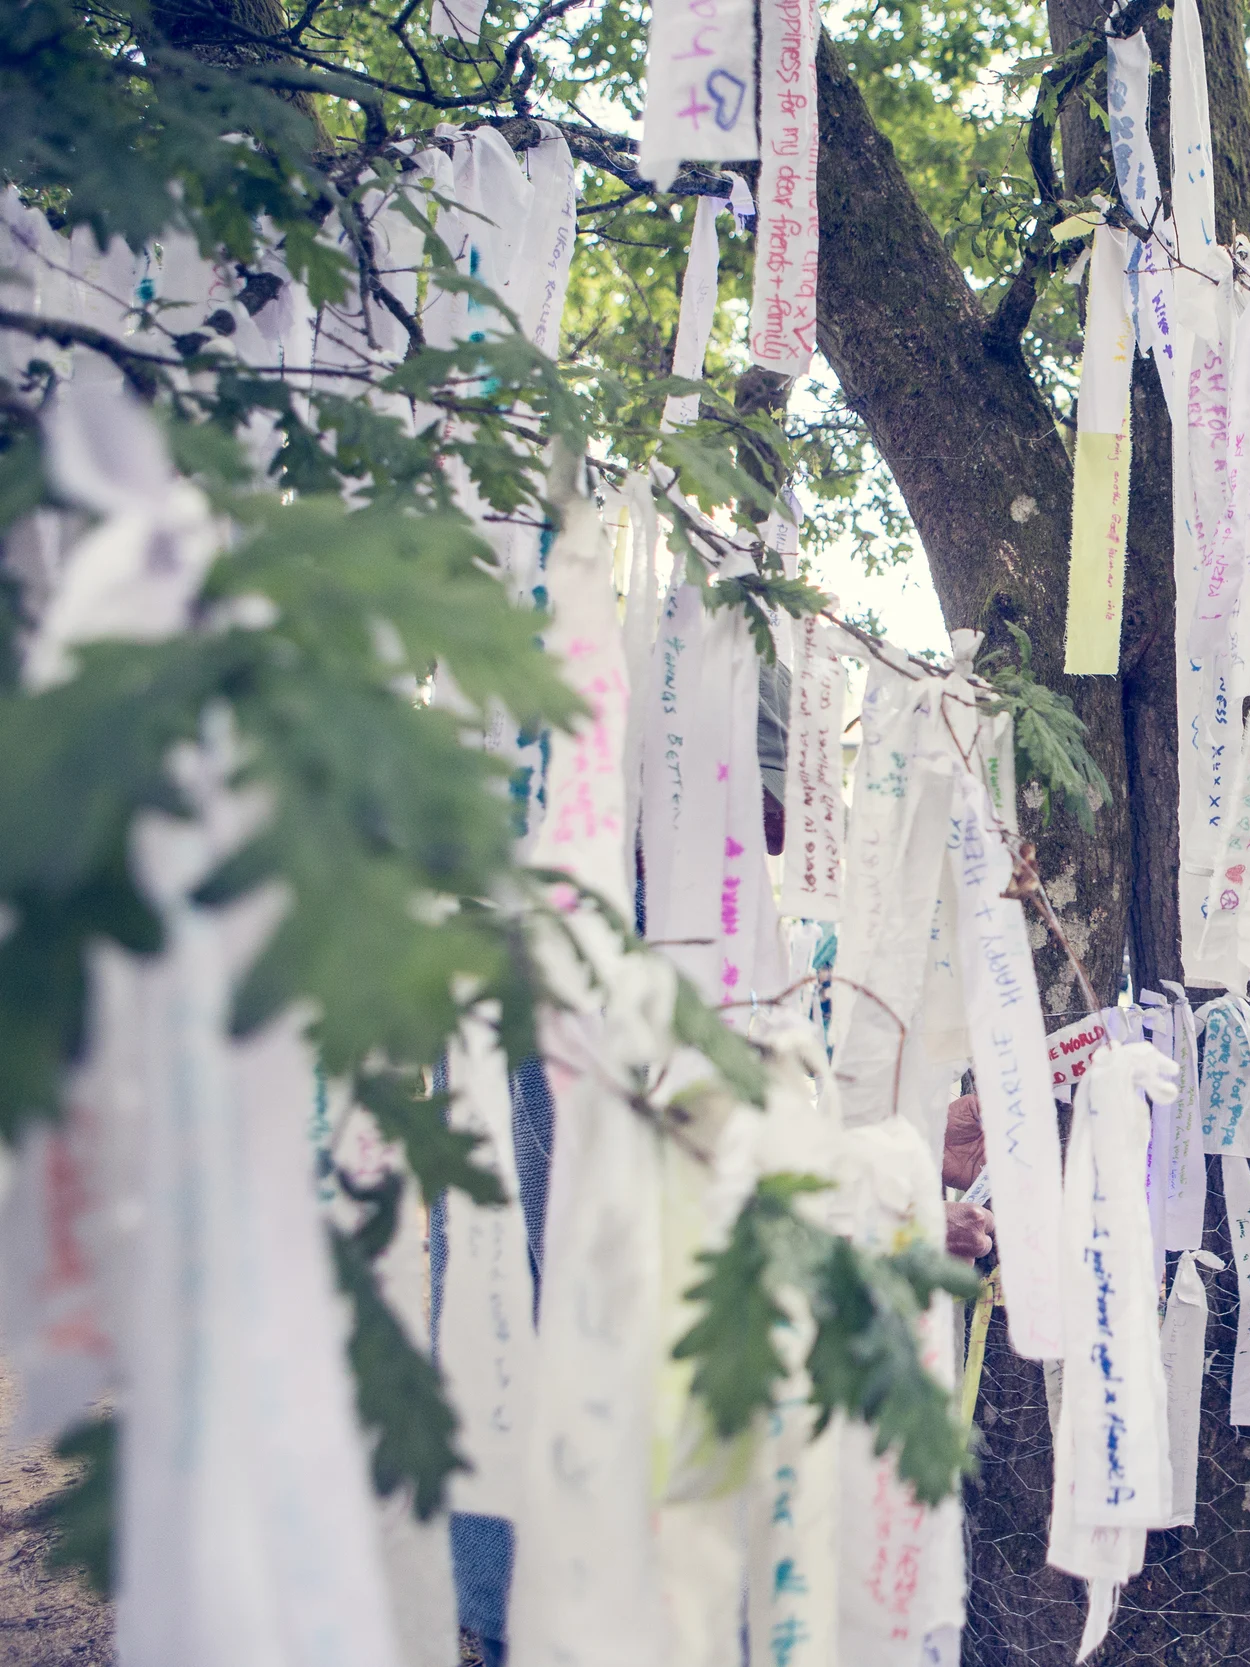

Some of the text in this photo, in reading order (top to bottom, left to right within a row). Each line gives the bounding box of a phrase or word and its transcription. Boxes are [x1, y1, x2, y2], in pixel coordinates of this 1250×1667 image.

[776, 88, 808, 121] for
[771, 126, 800, 157] my
[775, 166, 802, 209] dear
[752, 295, 792, 361] family
[979, 934, 1024, 1008] HAPPY
[1060, 1025, 1105, 1055] WORLD
[991, 1026, 1033, 1169] MARLIE
[1209, 1069, 1231, 1109] back
[1230, 1076, 1248, 1101] for
[1201, 1113, 1218, 1135] to
